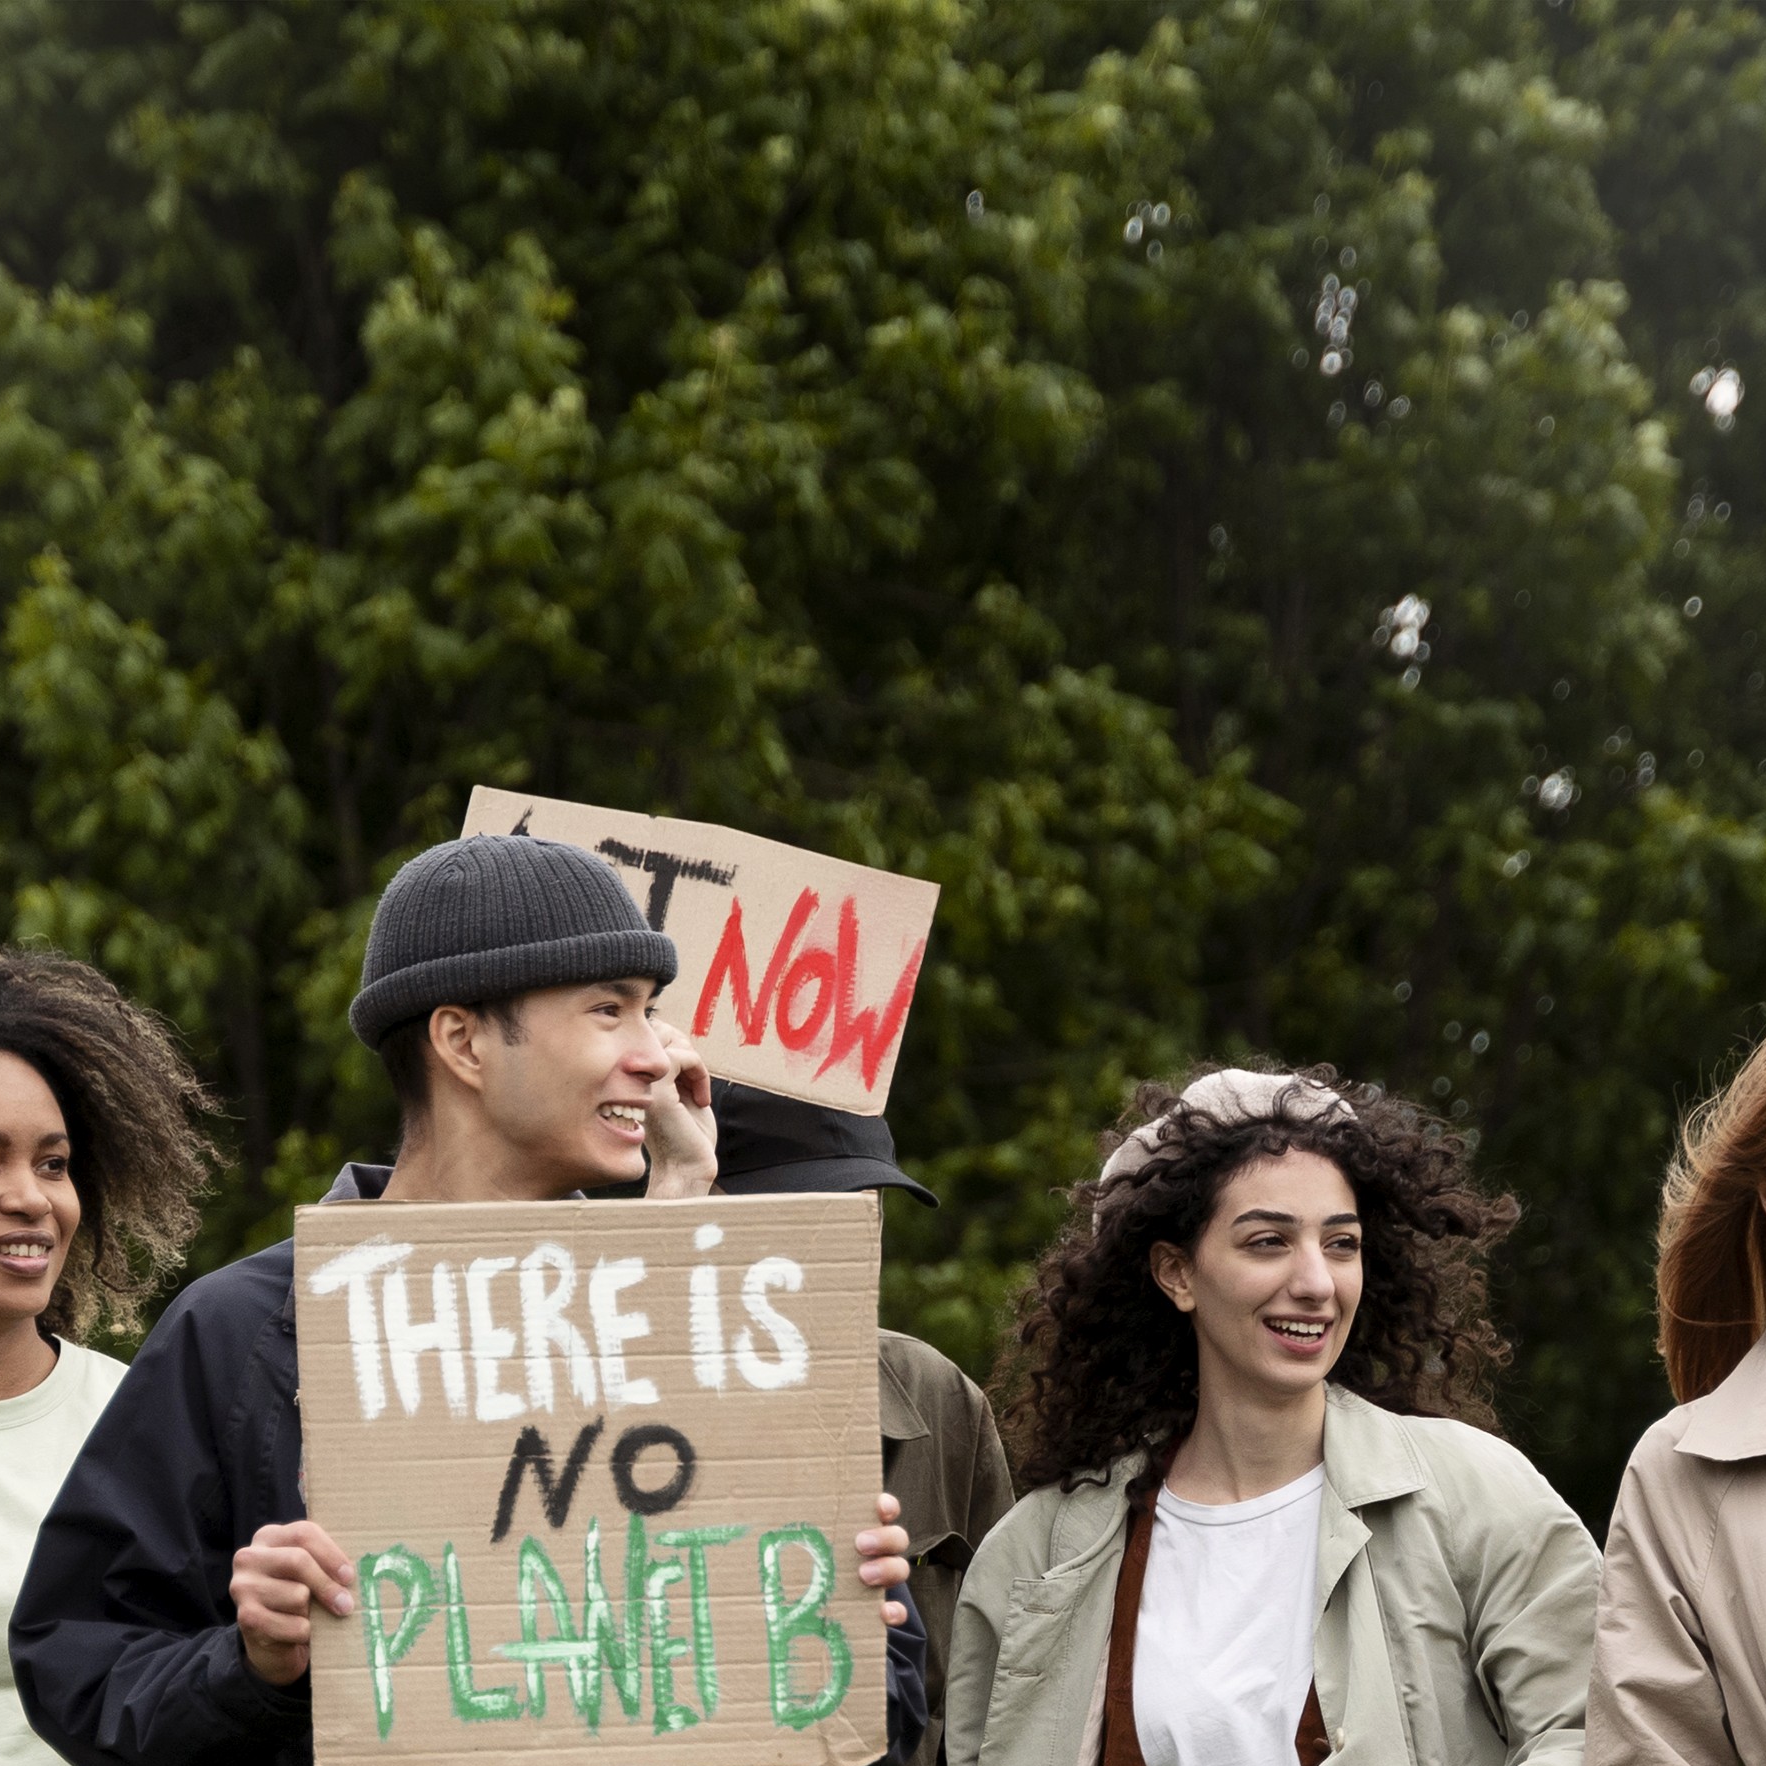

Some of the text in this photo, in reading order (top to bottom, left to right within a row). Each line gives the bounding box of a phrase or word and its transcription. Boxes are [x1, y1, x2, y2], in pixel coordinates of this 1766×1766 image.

[690, 884, 927, 1094] NOW
[308, 1233, 660, 1423] THERE
[489, 1414, 698, 1545] NO
[356, 1511, 855, 1743] PLANET B
